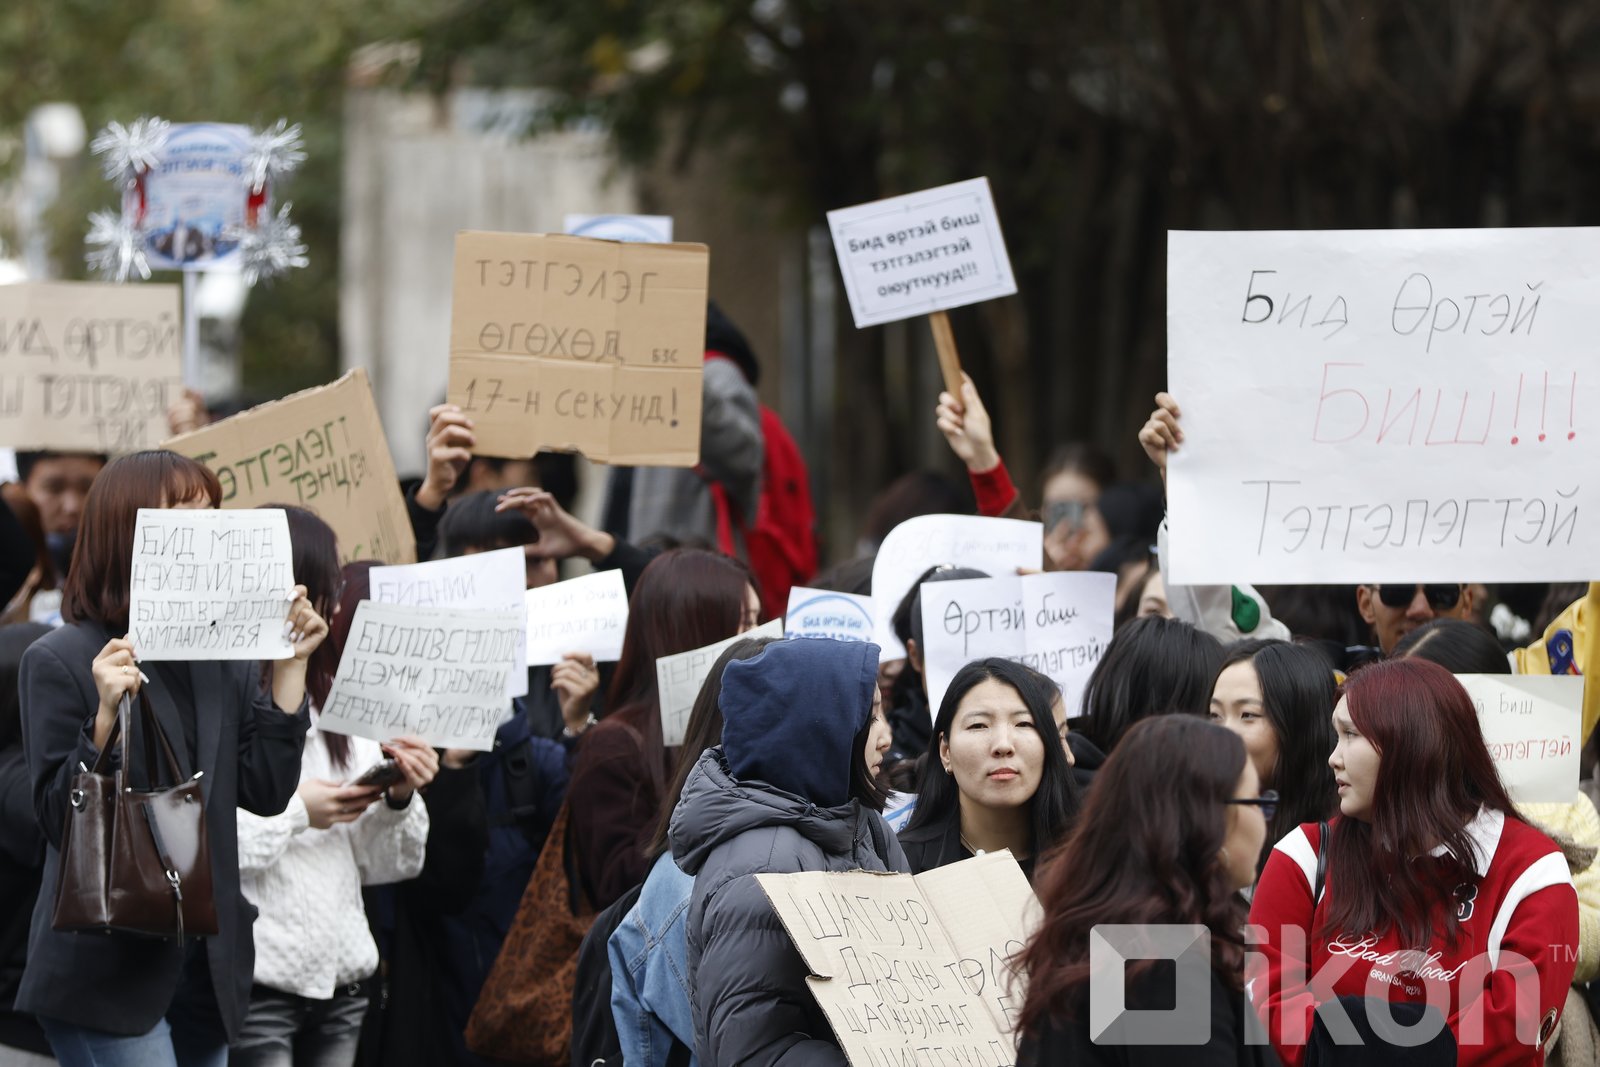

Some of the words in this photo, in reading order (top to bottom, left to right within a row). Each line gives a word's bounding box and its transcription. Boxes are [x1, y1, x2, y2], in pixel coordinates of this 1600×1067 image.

[887, 220, 937, 246] өртэй
[940, 212, 980, 231] биш
[870, 237, 973, 273] тэтгэлэгтэй
[475, 260, 659, 304] ТЭТГЭЛЭГ
[1242, 270, 1348, 341] Бид
[1392, 272, 1544, 353] Өртэй
[478, 322, 625, 365] ӨГӨХӨД
[1312, 362, 1577, 445] Биш!!!
[1242, 480, 1580, 556] Тэтгэлэгтэй
[140, 525, 195, 560] БИД
[241, 562, 286, 597] БИД
[943, 600, 1026, 657] Өртэй
[1036, 592, 1080, 627] биш
